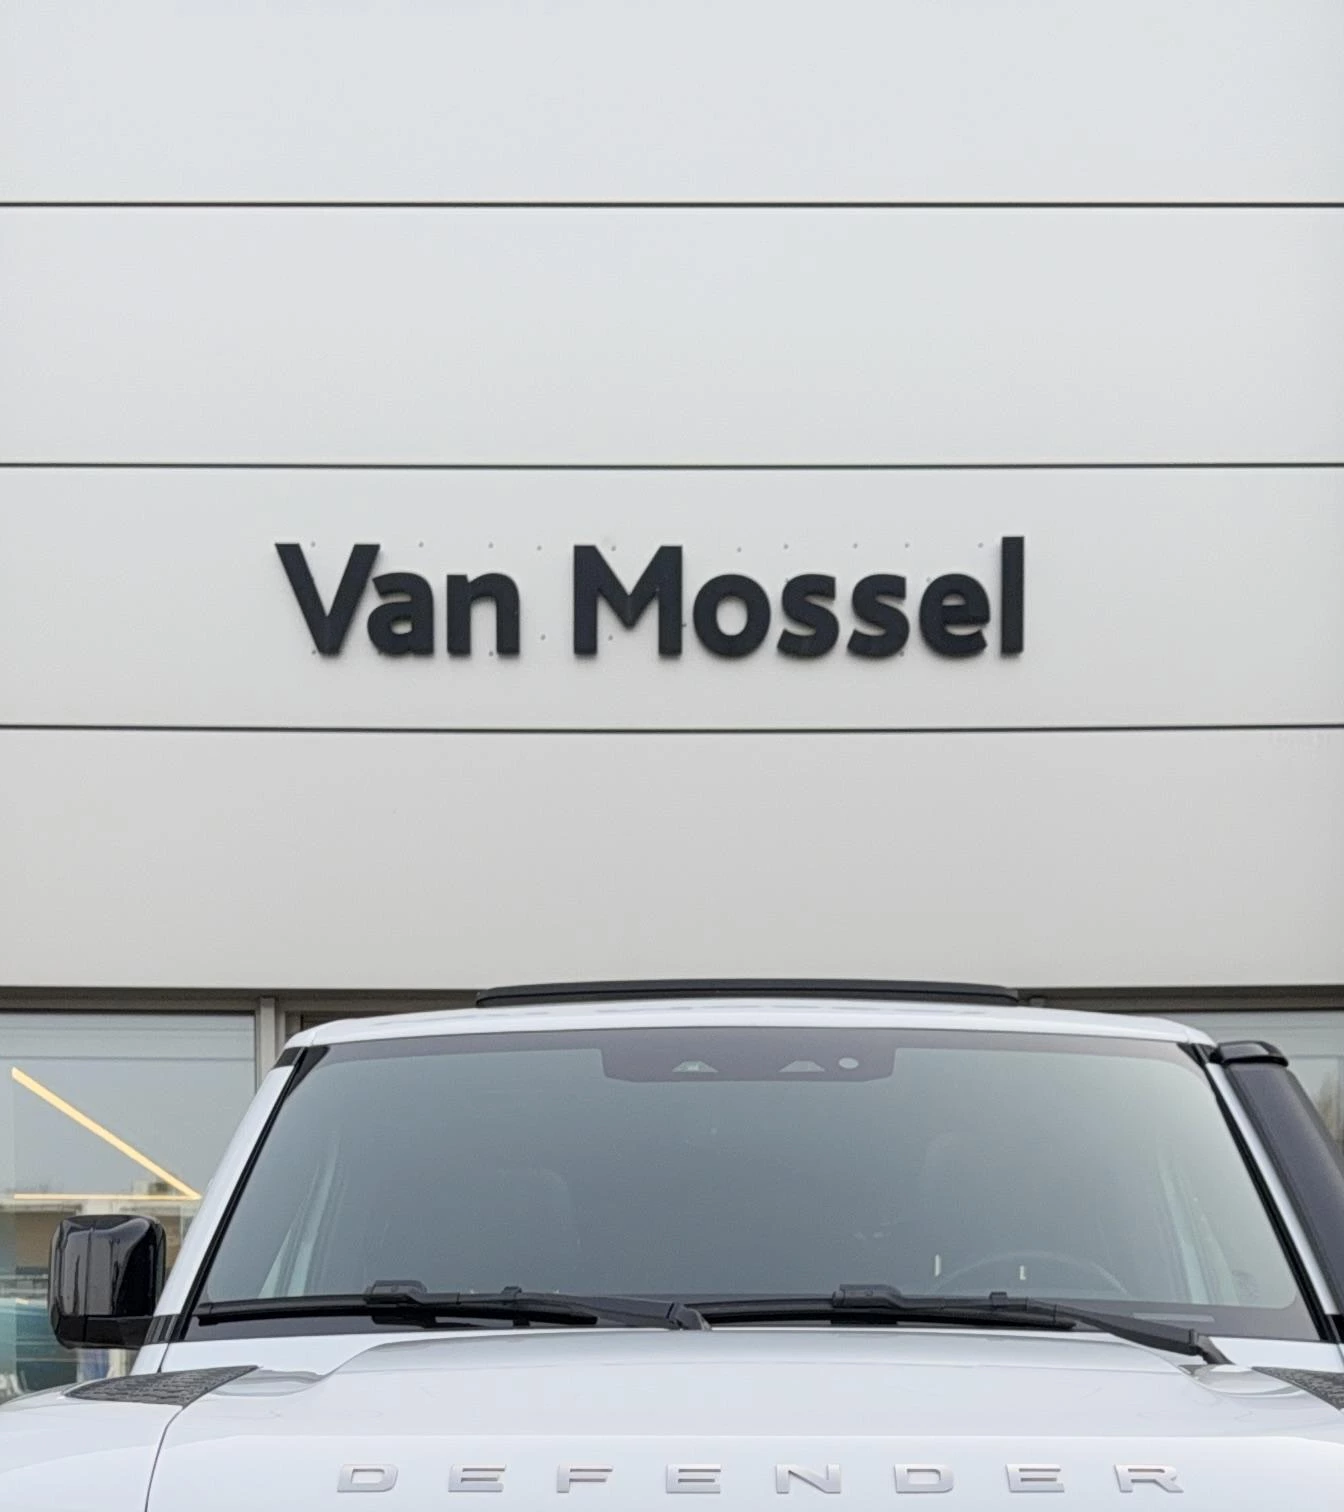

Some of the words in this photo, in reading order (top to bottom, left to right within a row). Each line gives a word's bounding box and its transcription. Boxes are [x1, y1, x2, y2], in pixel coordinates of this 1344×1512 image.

[274, 542, 521, 657] Van
[573, 535, 1025, 658] Mossel
[336, 1463, 1184, 1494] DEFENDER
